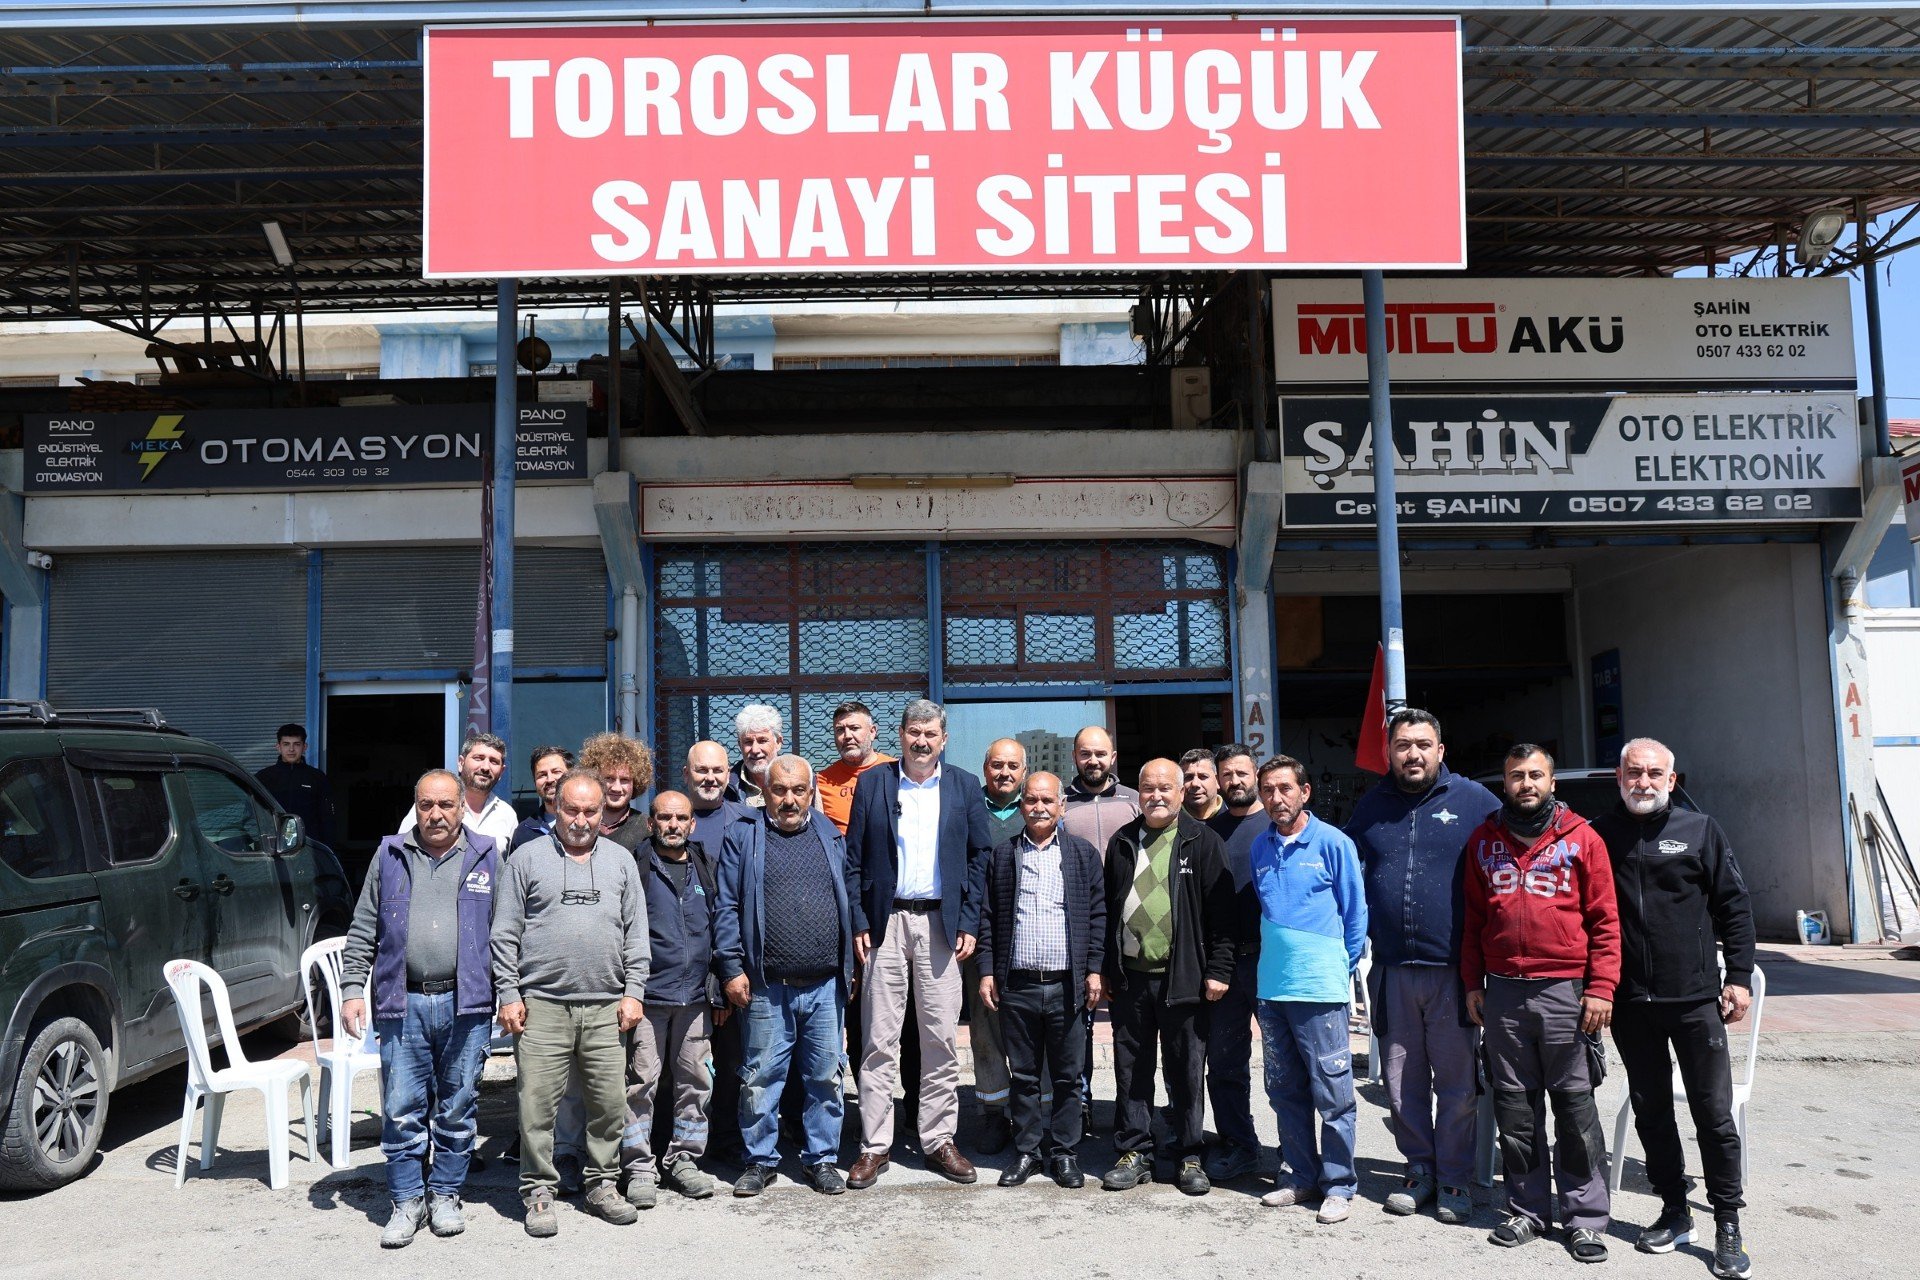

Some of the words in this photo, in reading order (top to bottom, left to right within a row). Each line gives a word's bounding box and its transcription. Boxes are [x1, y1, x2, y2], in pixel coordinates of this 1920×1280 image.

[492, 52, 1012, 138] TOROSLAR
[1049, 28, 1382, 154] KÜÇÜK
[590, 154, 936, 262] SANAYİ
[975, 152, 1288, 257] SİTESİ
[1693, 298, 1751, 318] ŞAHİN
[1297, 302, 1498, 354] MUTLU
[1508, 316, 1624, 354] AKÜ
[1695, 324, 1733, 338] OTO
[1738, 320, 1830, 337] ELEKTRİK
[1696, 345, 1731, 358] 0507
[1736, 345, 1762, 358] 433
[1766, 344, 1784, 357] 62
[1788, 344, 1806, 357] 02
[520, 409, 567, 420] PANO
[49, 420, 95, 432] PANO
[1618, 415, 1684, 442] OTO
[1693, 405, 1837, 441] ELEKTRİK
[515, 431, 575, 442] NDÜSTRİYEL
[37, 441, 103, 453] ENDÜSTRİYEL
[131, 440, 183, 451] MEKA
[200, 432, 481, 465] OTOMASYON
[517, 443, 568, 456] ELEKTRİK
[1303, 408, 1573, 487] ŞAHİN
[45, 454, 97, 467] ELEKTRİK
[515, 460, 575, 471] TOMASYON
[1635, 446, 1826, 482] ELEKTRONİK
[35, 472, 103, 483] OTOMASYON
[286, 469, 316, 478] 0544
[323, 468, 346, 477] 303
[352, 468, 368, 477] 09
[374, 467, 390, 476] 32
[1427, 494, 1521, 519] ŞAHİN
[1569, 496, 1646, 513] 0507
[1656, 495, 1715, 511] 433
[1725, 495, 1764, 510] 62
[1774, 494, 1813, 509] 02
